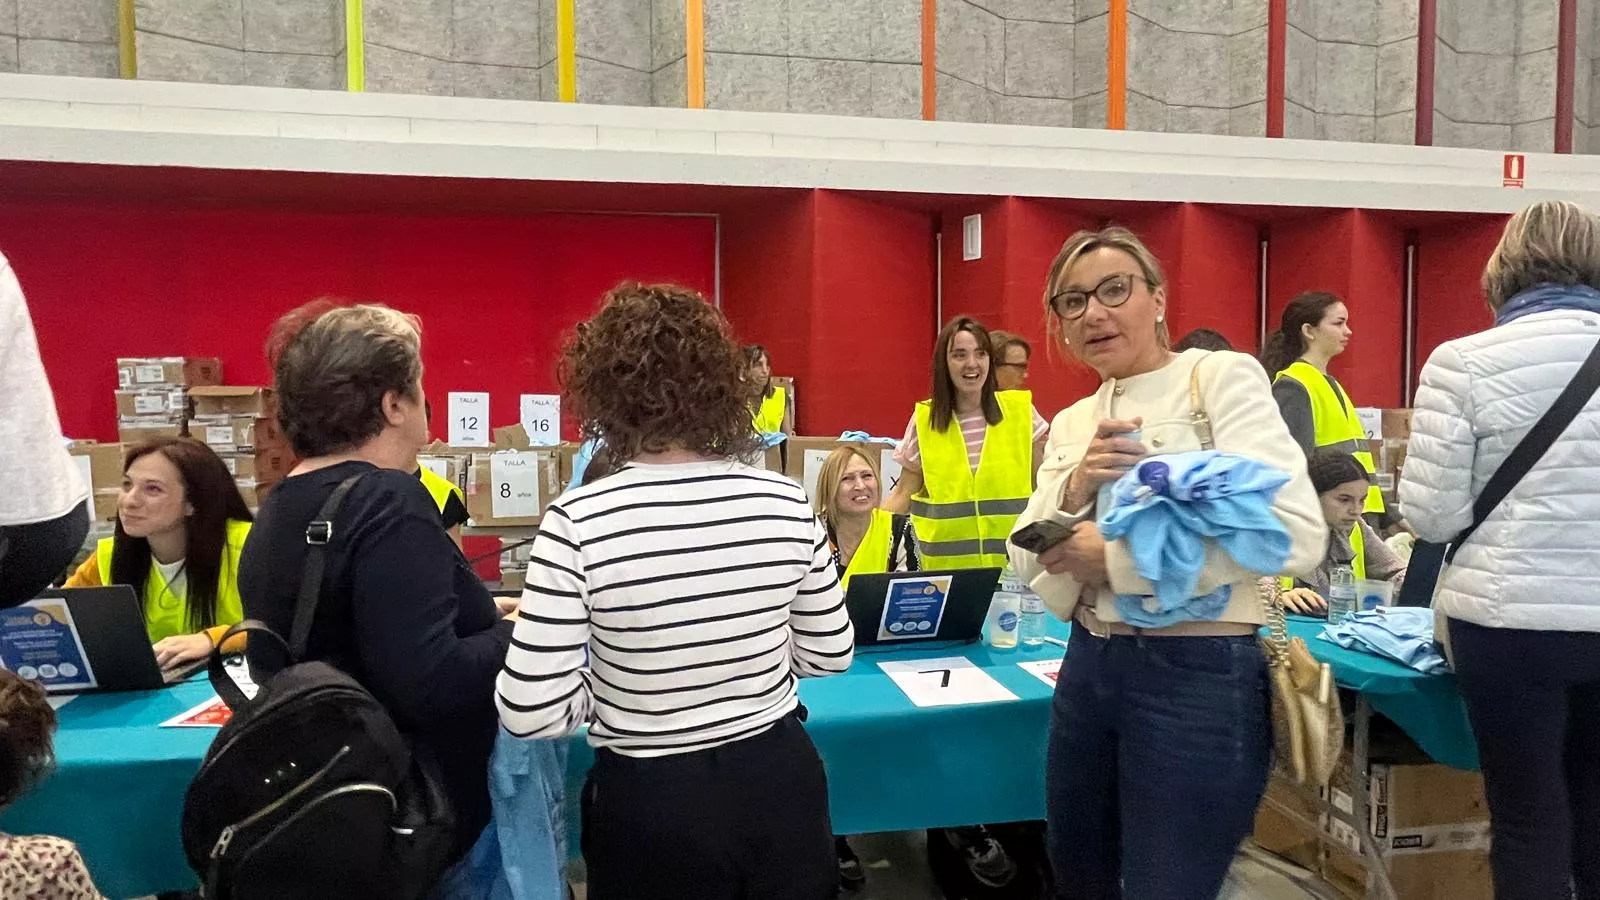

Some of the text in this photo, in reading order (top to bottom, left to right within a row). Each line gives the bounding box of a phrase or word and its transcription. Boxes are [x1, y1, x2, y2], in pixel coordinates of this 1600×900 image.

[460, 416, 478, 430] 12
[532, 419, 550, 432] 16
[500, 482, 511, 498] 8
